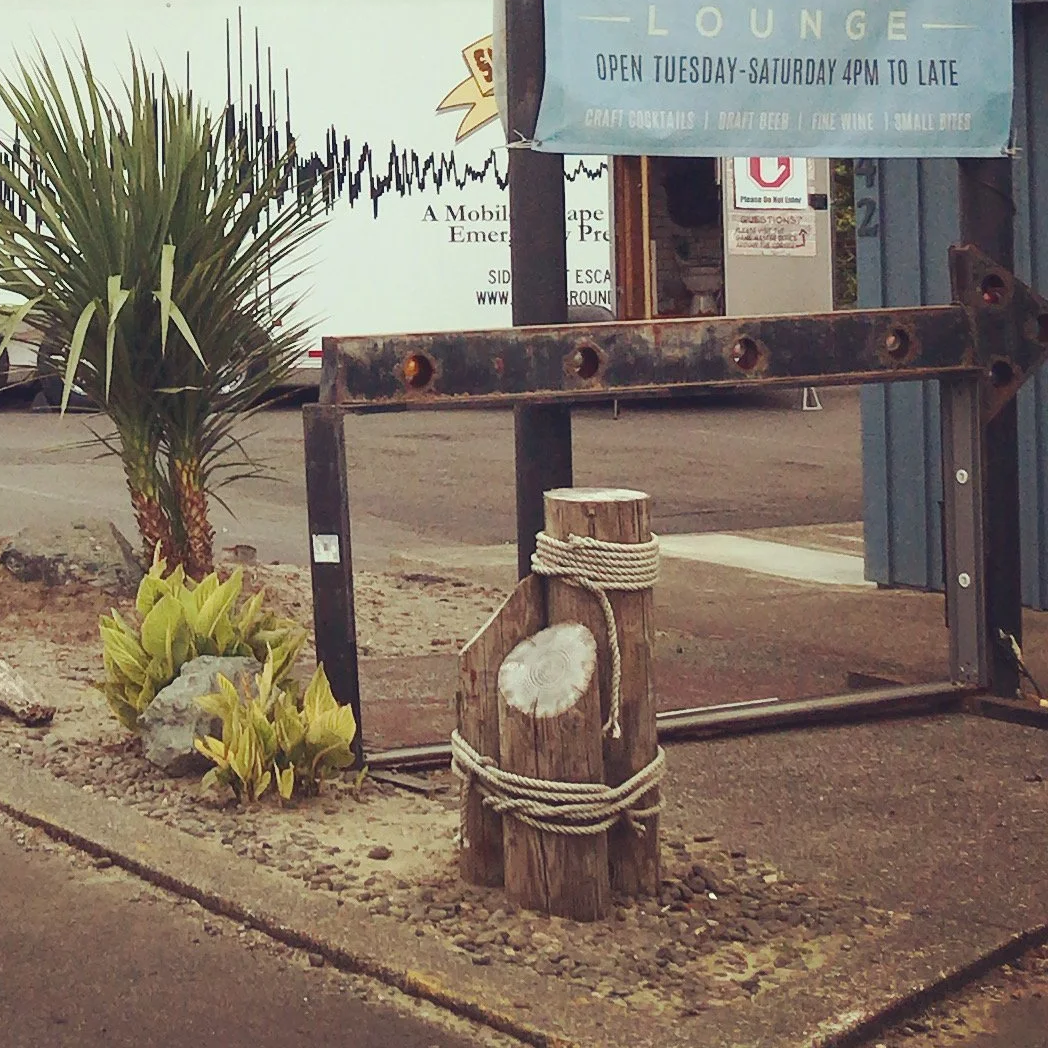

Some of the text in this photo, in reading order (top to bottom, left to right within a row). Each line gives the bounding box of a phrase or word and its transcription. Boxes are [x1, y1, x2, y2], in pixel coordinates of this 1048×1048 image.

[647, 4, 908, 41] LOUNGE
[597, 53, 959, 87] OPEN TUESDAY-SATURDAY 4PM TO LATE
[584, 108, 623, 129] CRAFT
[628, 109, 696, 130] COCKTAILS
[718, 111, 755, 130] DRAFT
[812, 112, 836, 131] FINE
[840, 112, 873, 131] WINE
[894, 112, 934, 131] SMALL
[740, 196, 762, 204] Please
[421, 205, 439, 222] A
[445, 205, 510, 222] Mobil
